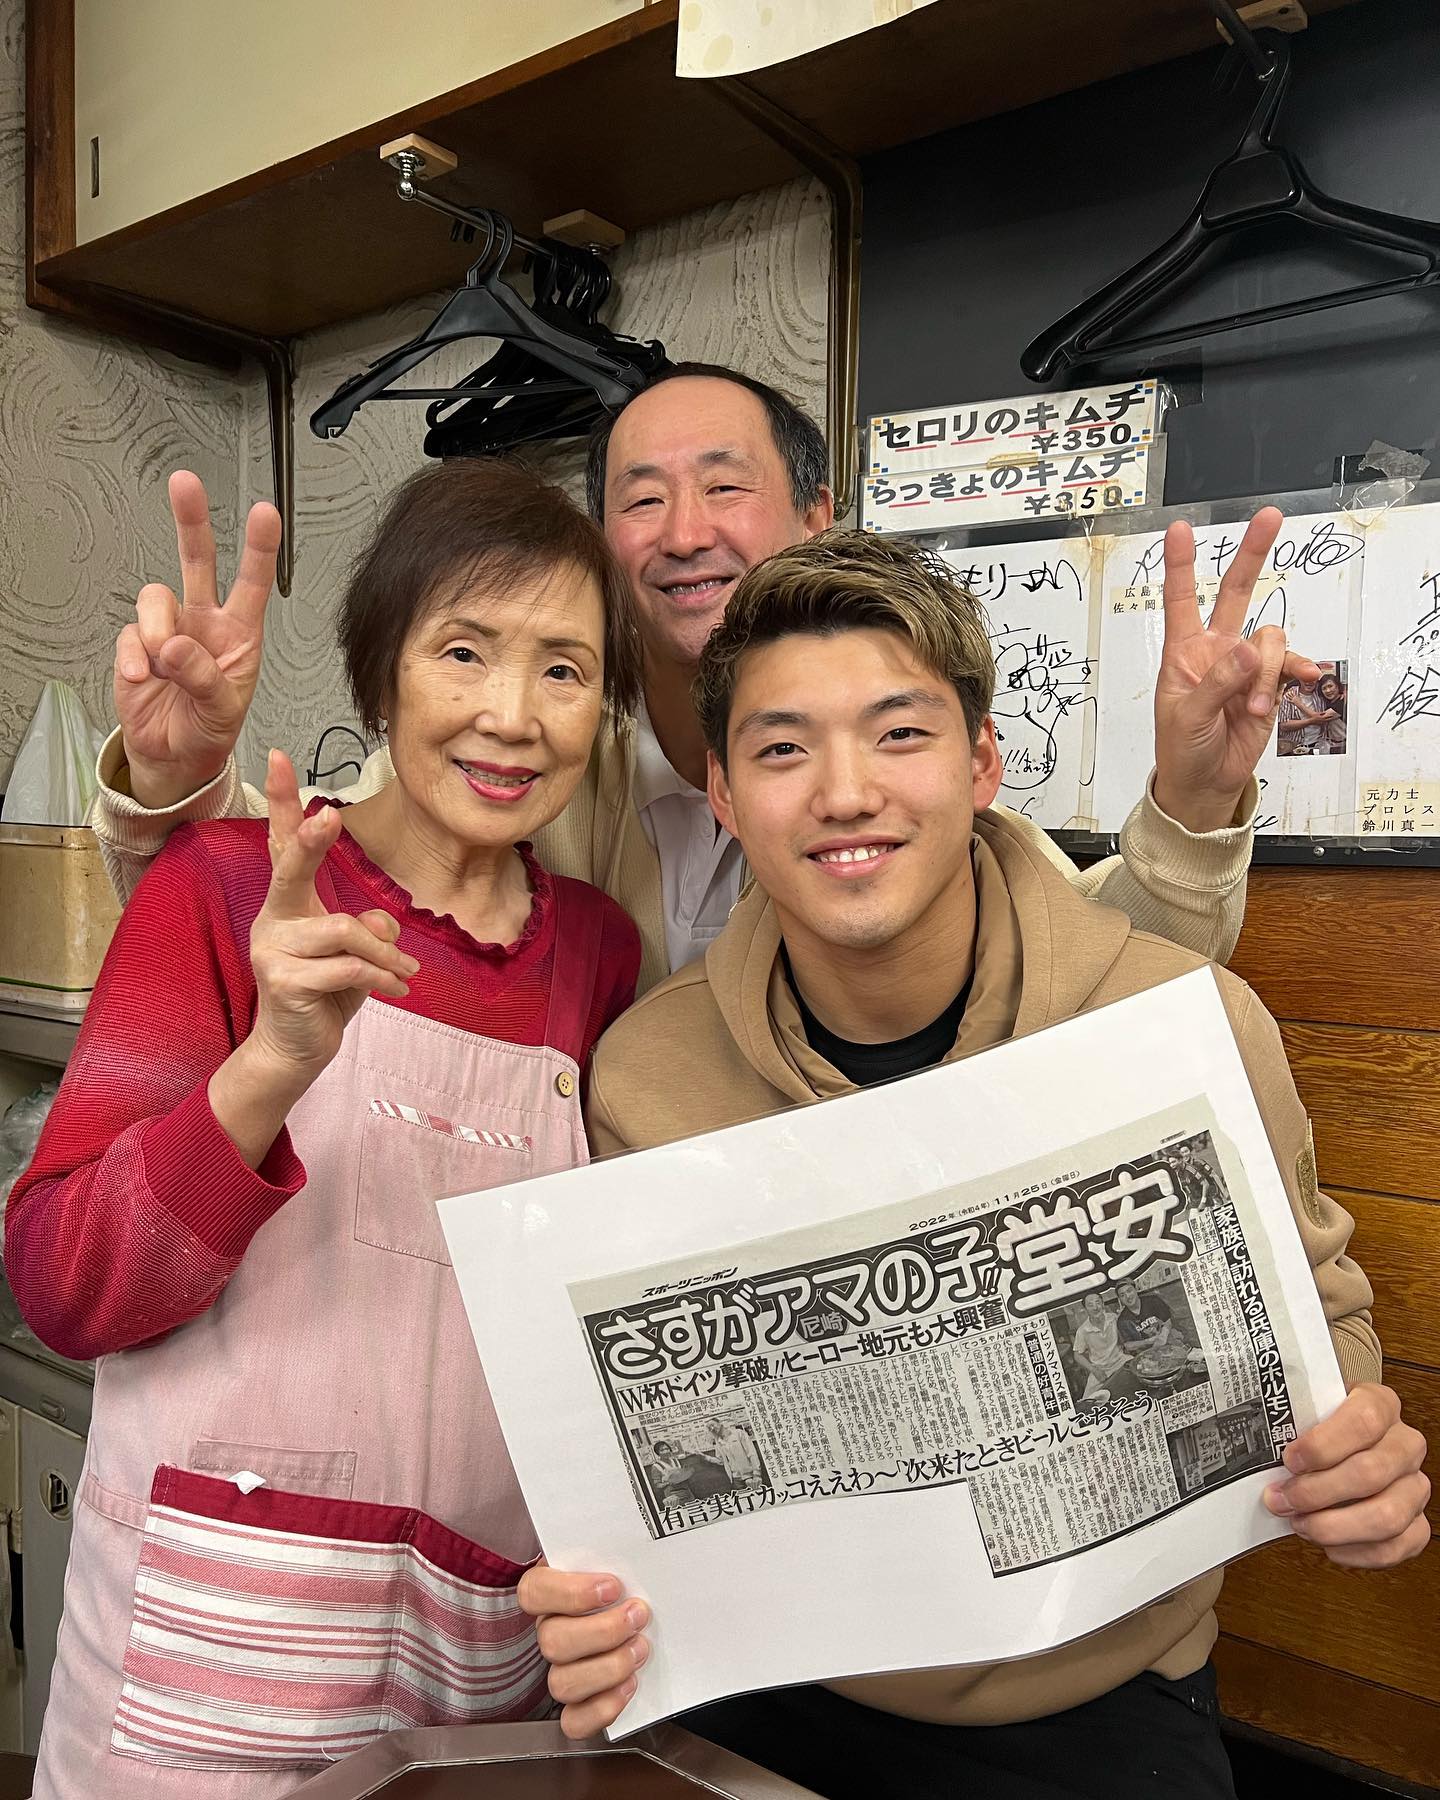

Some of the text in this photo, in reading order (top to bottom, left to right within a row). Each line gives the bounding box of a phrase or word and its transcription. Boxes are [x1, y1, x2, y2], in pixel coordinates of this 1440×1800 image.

[879, 387, 1146, 449] セロリのキムチ
[1031, 423, 1132, 454] ¥350
[871, 447, 1137, 505] らっきょのキムチ
[1363, 803, 1434, 816] プロレス
[1366, 788, 1419, 801] 元力士
[1362, 819, 1435, 833] 鈴川真一
[997, 1164, 1186, 1318] 堂安
[641, 1267, 739, 1299] スポーツニッポン
[801, 1310, 845, 1339] 尼崎
[962, 1317, 1047, 1351] てっちゃん鍋やすもり
